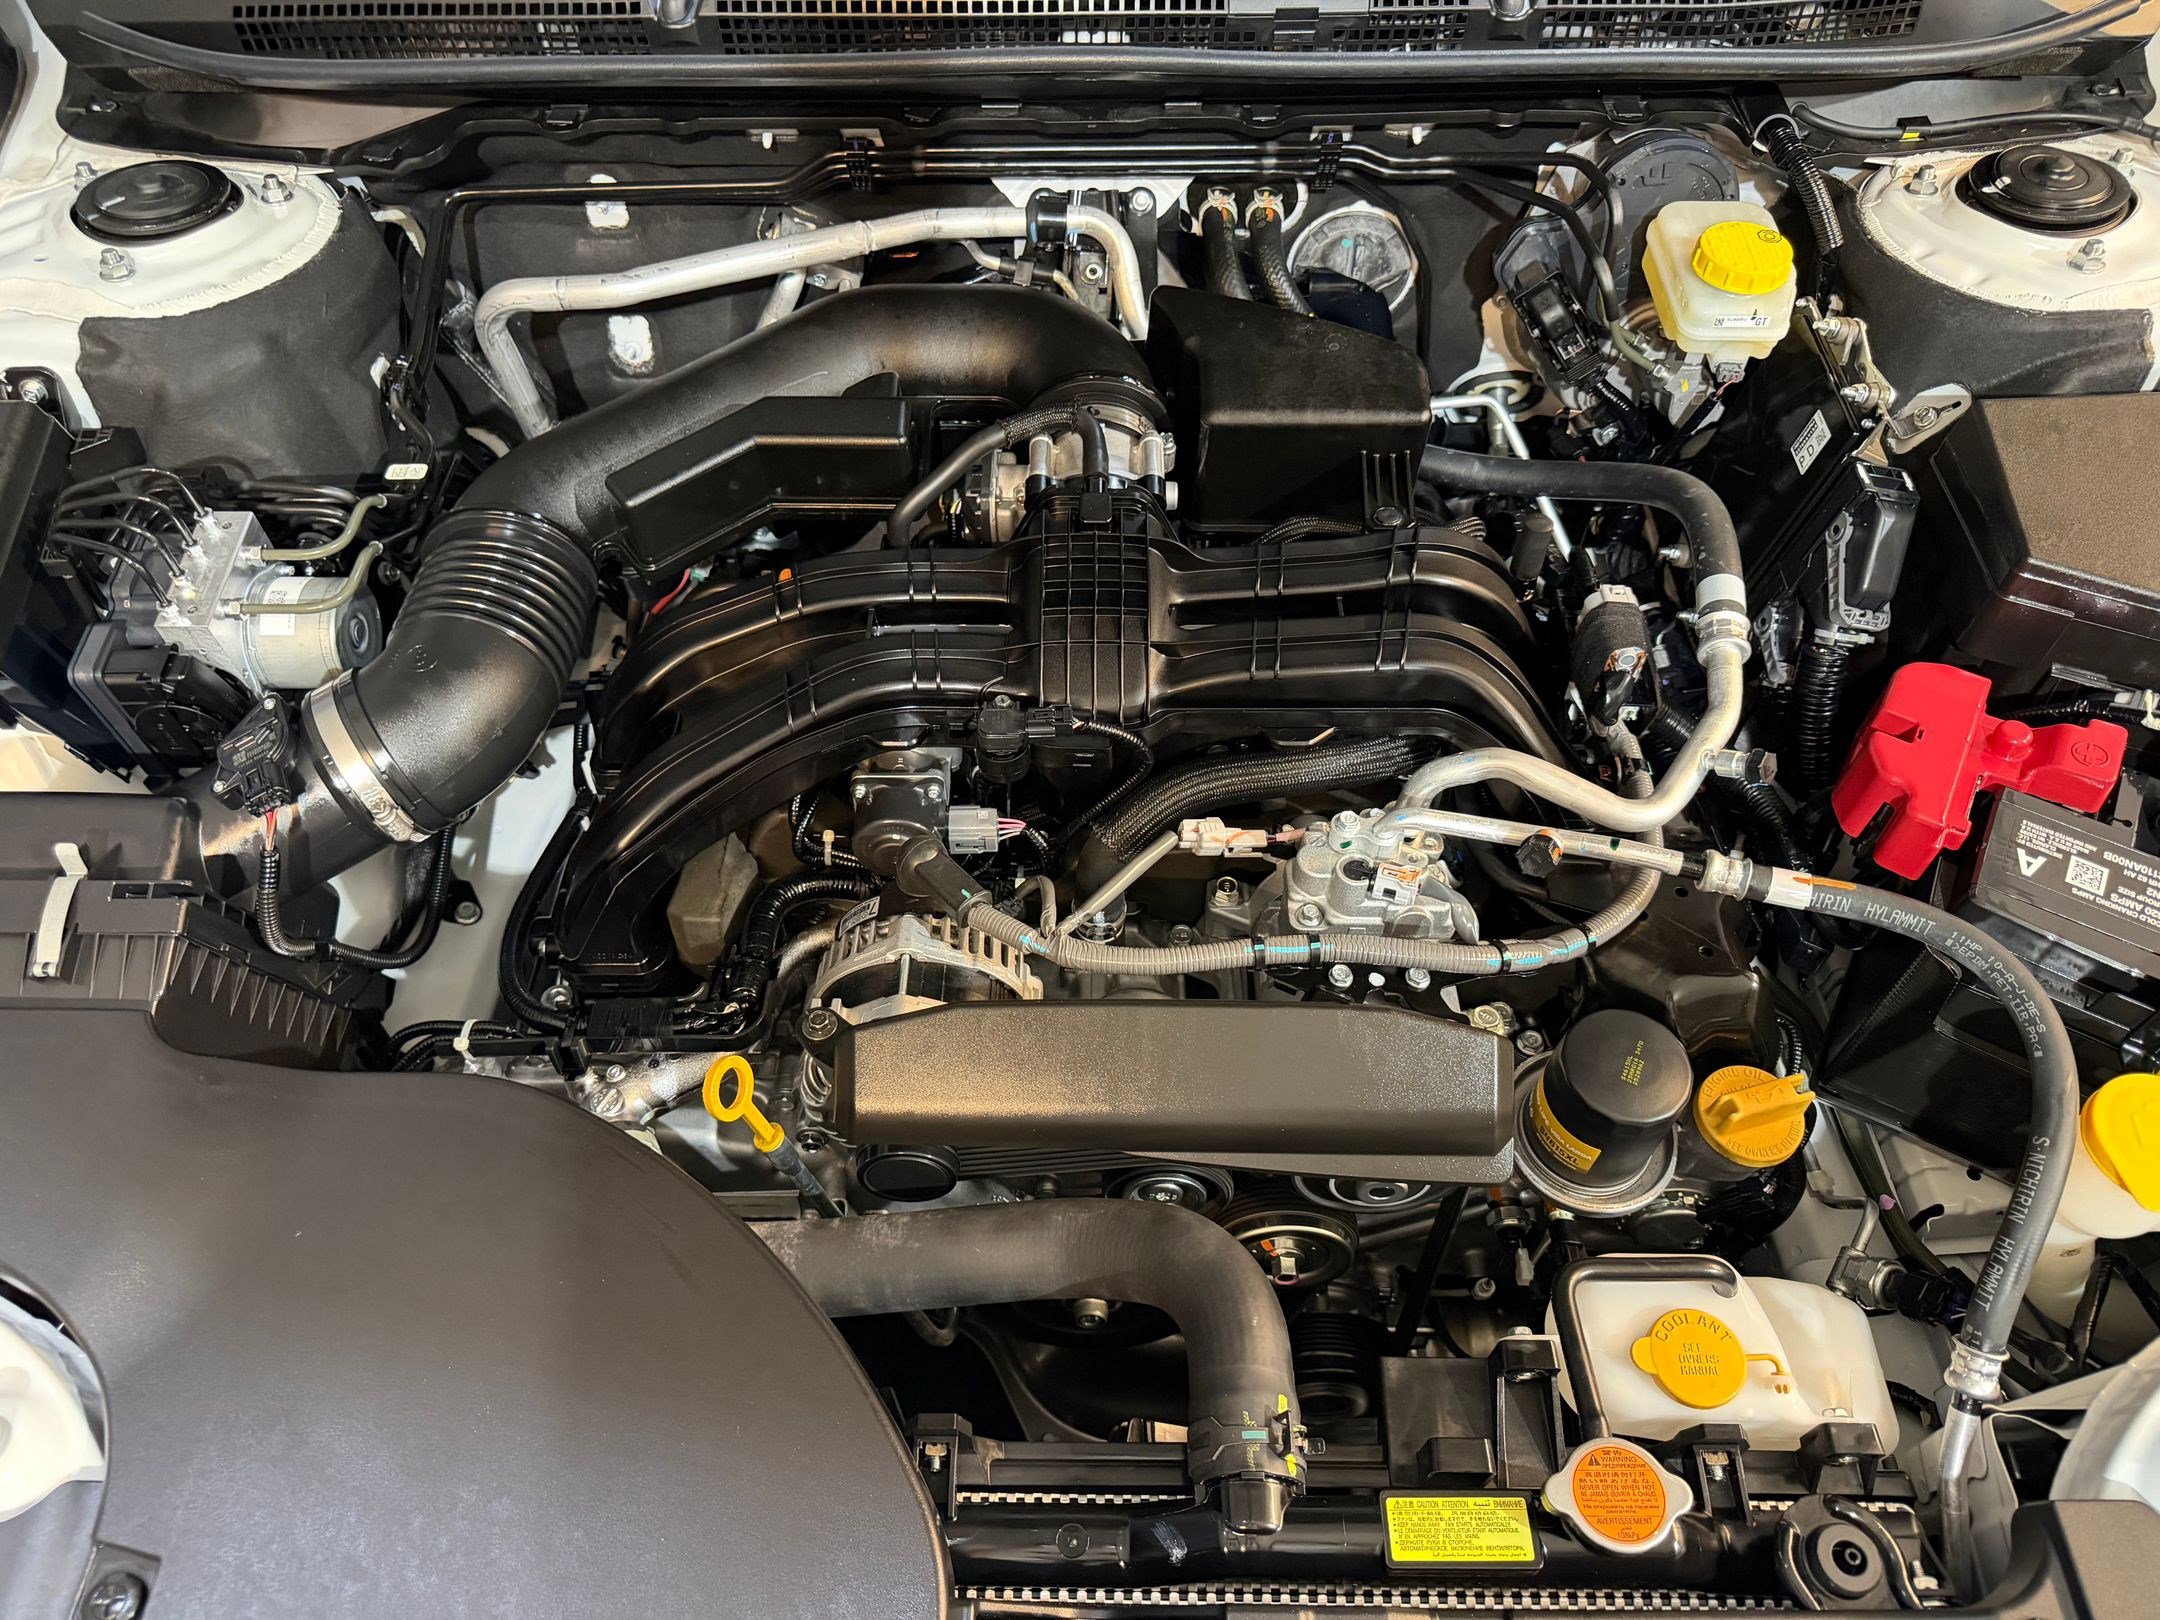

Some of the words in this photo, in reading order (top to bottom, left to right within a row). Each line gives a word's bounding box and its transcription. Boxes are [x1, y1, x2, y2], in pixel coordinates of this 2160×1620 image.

[1755, 317, 1768, 326] GT
[2017, 848, 2047, 877] A
[2103, 851, 2160, 879] 110AN00B
[2124, 869, 2137, 878] AH
[2072, 888, 2095, 900] AMPS
[2118, 886, 2136, 897] SIZE
[2096, 897, 2138, 918] CRANKING
[2111, 893, 2143, 911] AMPS
[1864, 903, 1936, 935] HYLAMMIT
[1743, 1068, 1768, 1082] OIL
[1726, 1138, 1744, 1152] SEE
[1974, 1234, 2015, 1312] HYLAMMIT
[1682, 1342, 1702, 1353] SEE
[1680, 1366, 1720, 1376] MANUAL
